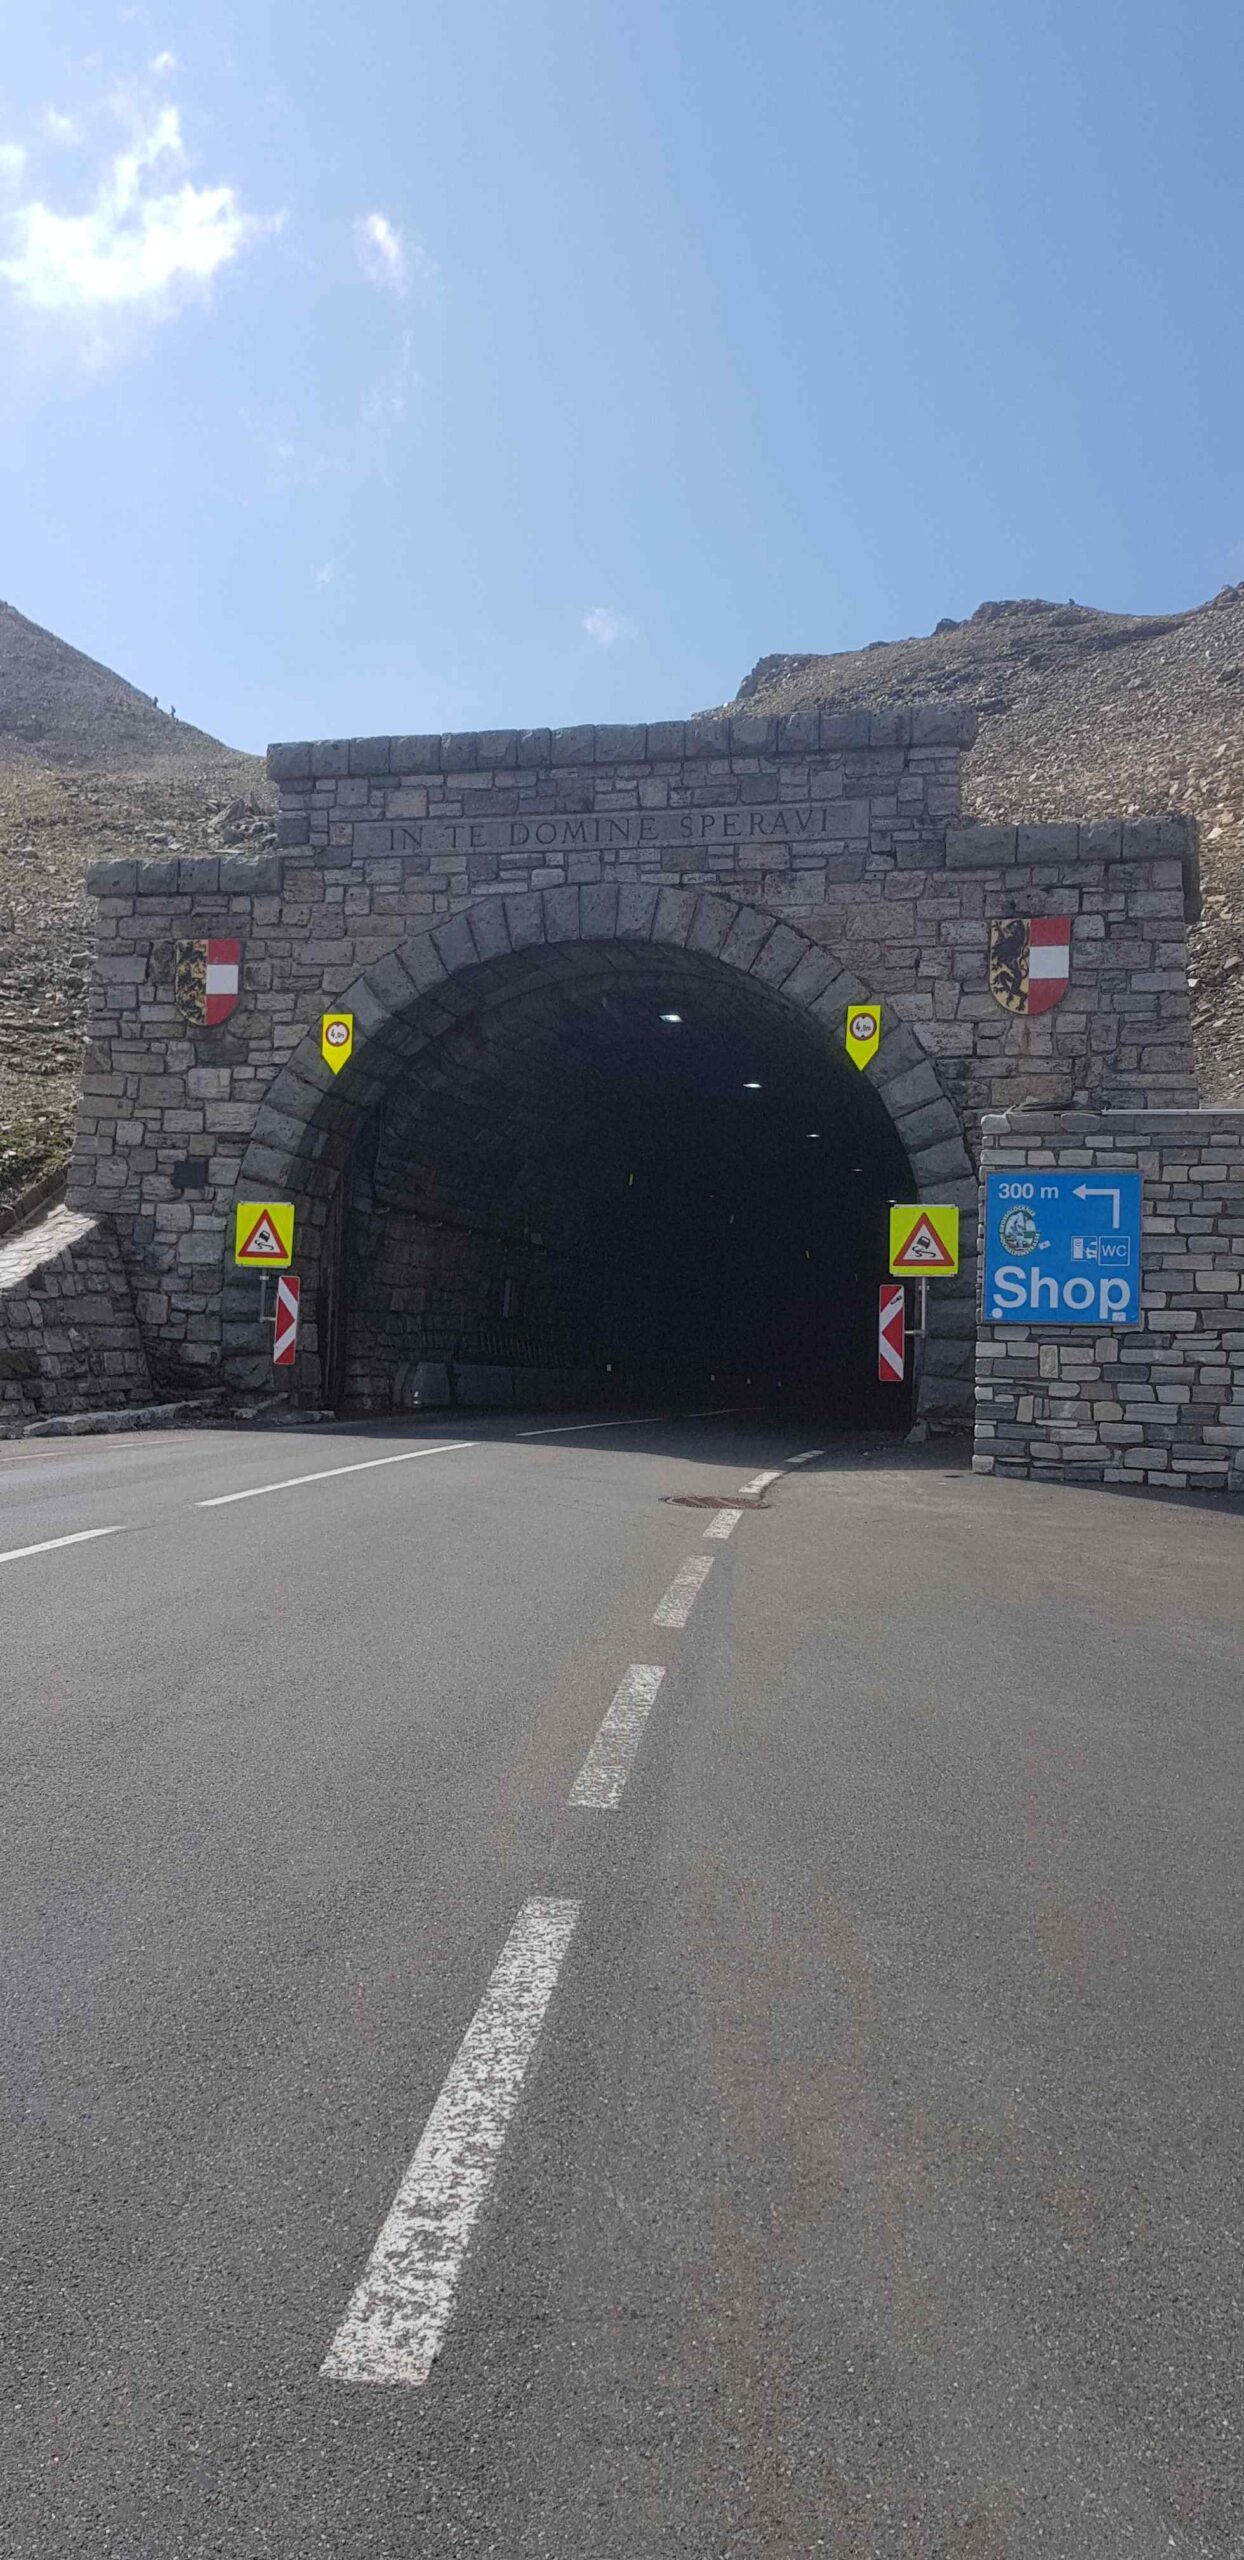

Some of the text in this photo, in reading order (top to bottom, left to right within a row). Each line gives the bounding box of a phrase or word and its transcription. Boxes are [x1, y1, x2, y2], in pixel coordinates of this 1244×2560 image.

[389, 808, 828, 851] IN TE DOMINE SPERAVI
[997, 1182, 1059, 1199] 300 m
[1101, 1244, 1128, 1257] WC
[993, 1265, 1131, 1319] Shop
